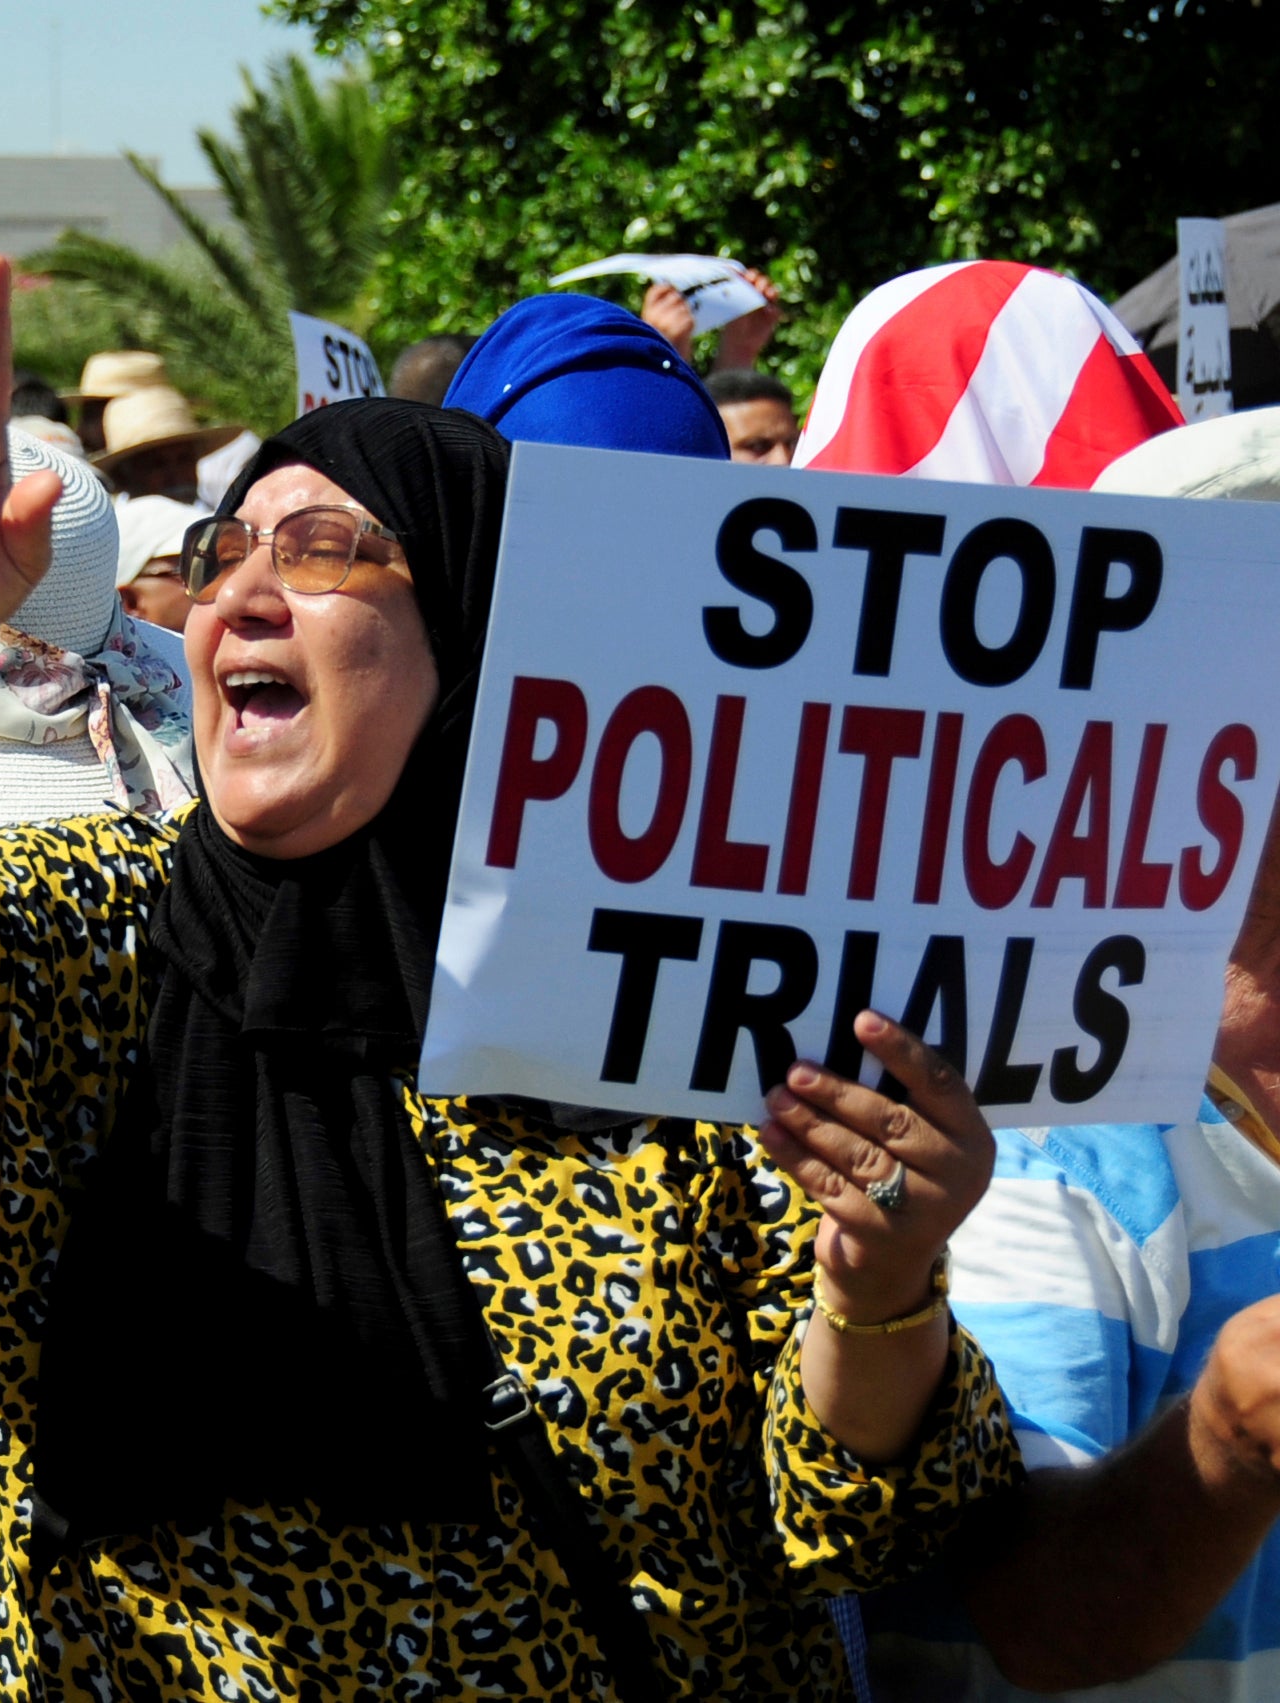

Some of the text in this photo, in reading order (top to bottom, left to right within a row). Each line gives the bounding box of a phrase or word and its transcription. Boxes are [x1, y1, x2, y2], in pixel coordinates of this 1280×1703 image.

[702, 497, 1164, 690] STOP
[485, 675, 1258, 912] POLITICALS
[586, 907, 1146, 1105] TRIALS
